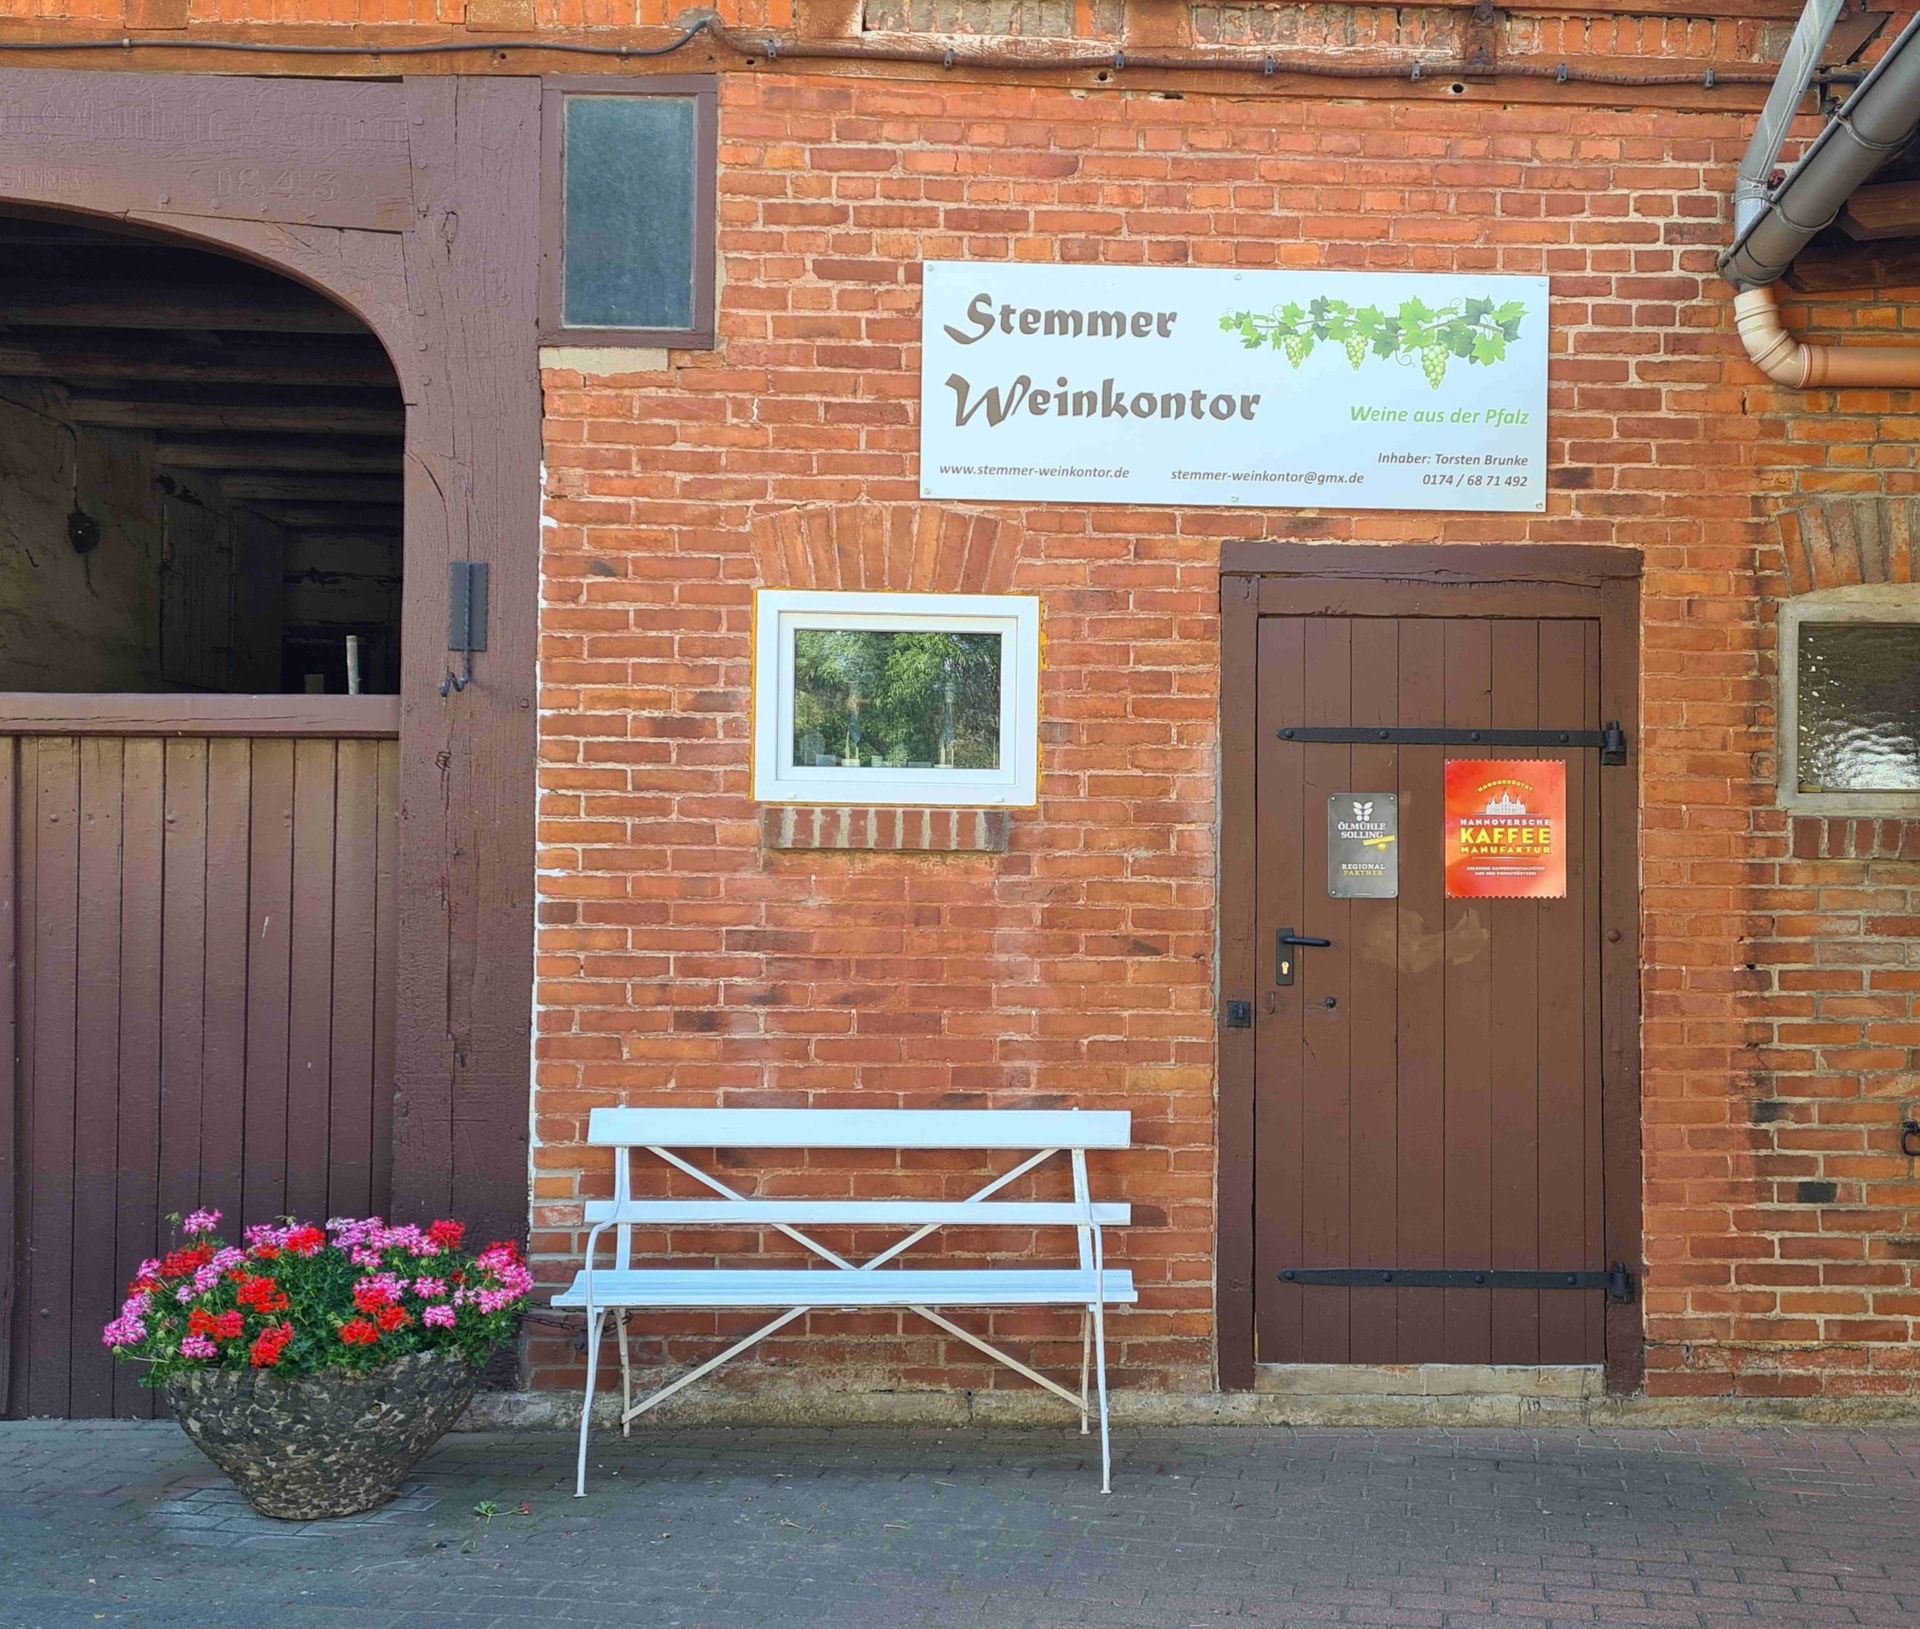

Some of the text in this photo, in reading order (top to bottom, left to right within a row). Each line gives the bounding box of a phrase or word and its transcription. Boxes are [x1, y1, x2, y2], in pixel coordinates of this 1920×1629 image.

[943, 293, 1178, 345] Stemmer
[944, 372, 1261, 428] Weinkontor
[1350, 405, 1529, 427] Weine aus der Pfalz
[1377, 452, 1528, 467] Inhaber: Torsten Brunke
[939, 464, 1130, 479] www.stemmer-weinkontor.de
[1170, 470, 1365, 485] stemmer-weinkontor@gmx.de
[1422, 474, 1528, 487] 0174 / 68 71 492
[1338, 821, 1386, 830] ÖLMÜHLE
[1341, 831, 1383, 839] SOLLING
[1460, 827, 1551, 844] KAFFEE
[1460, 846, 1551, 854] MANUFAKTUR
